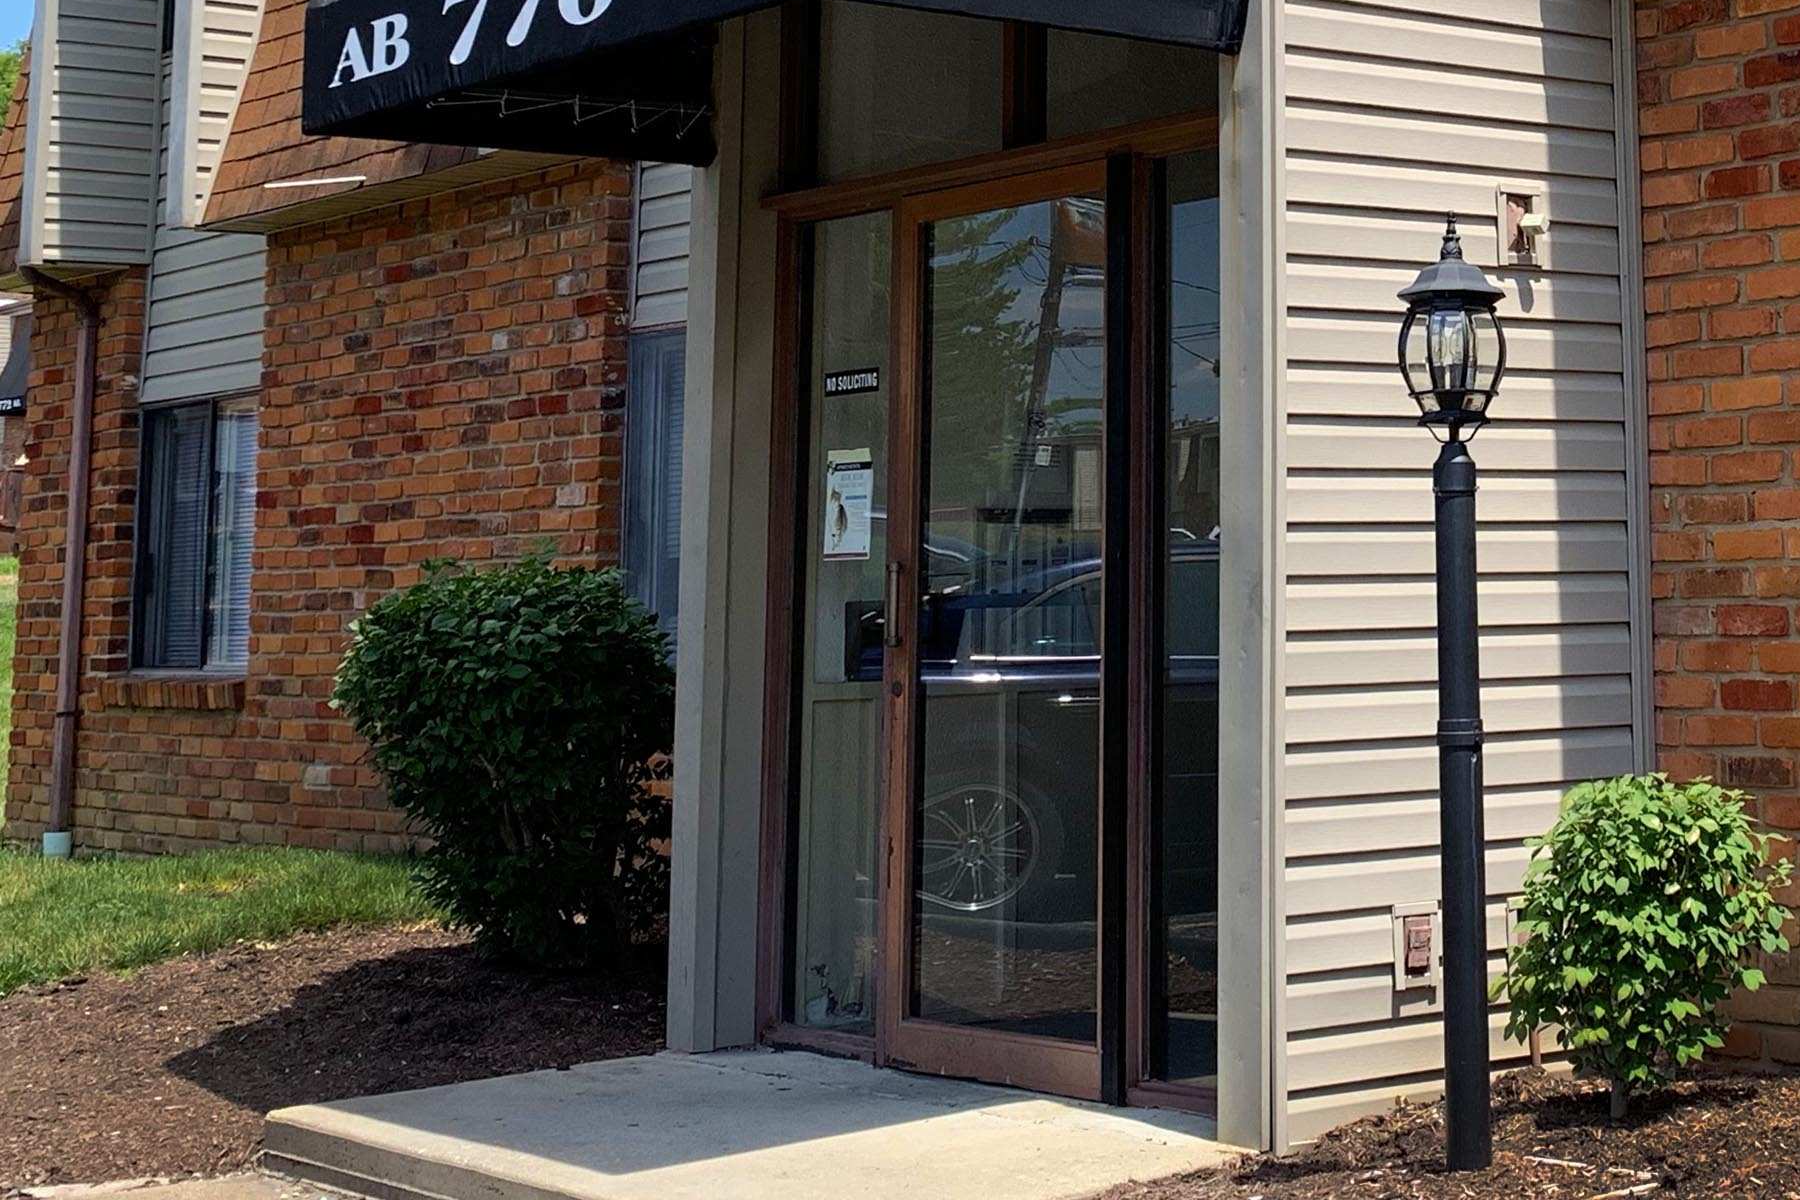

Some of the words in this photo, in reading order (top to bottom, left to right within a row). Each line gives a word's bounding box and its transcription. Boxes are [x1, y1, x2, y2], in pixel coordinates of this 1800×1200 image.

[328, 13, 410, 88] AB
[826, 377, 837, 392] NO
[837, 372, 878, 390] SOLICITING
